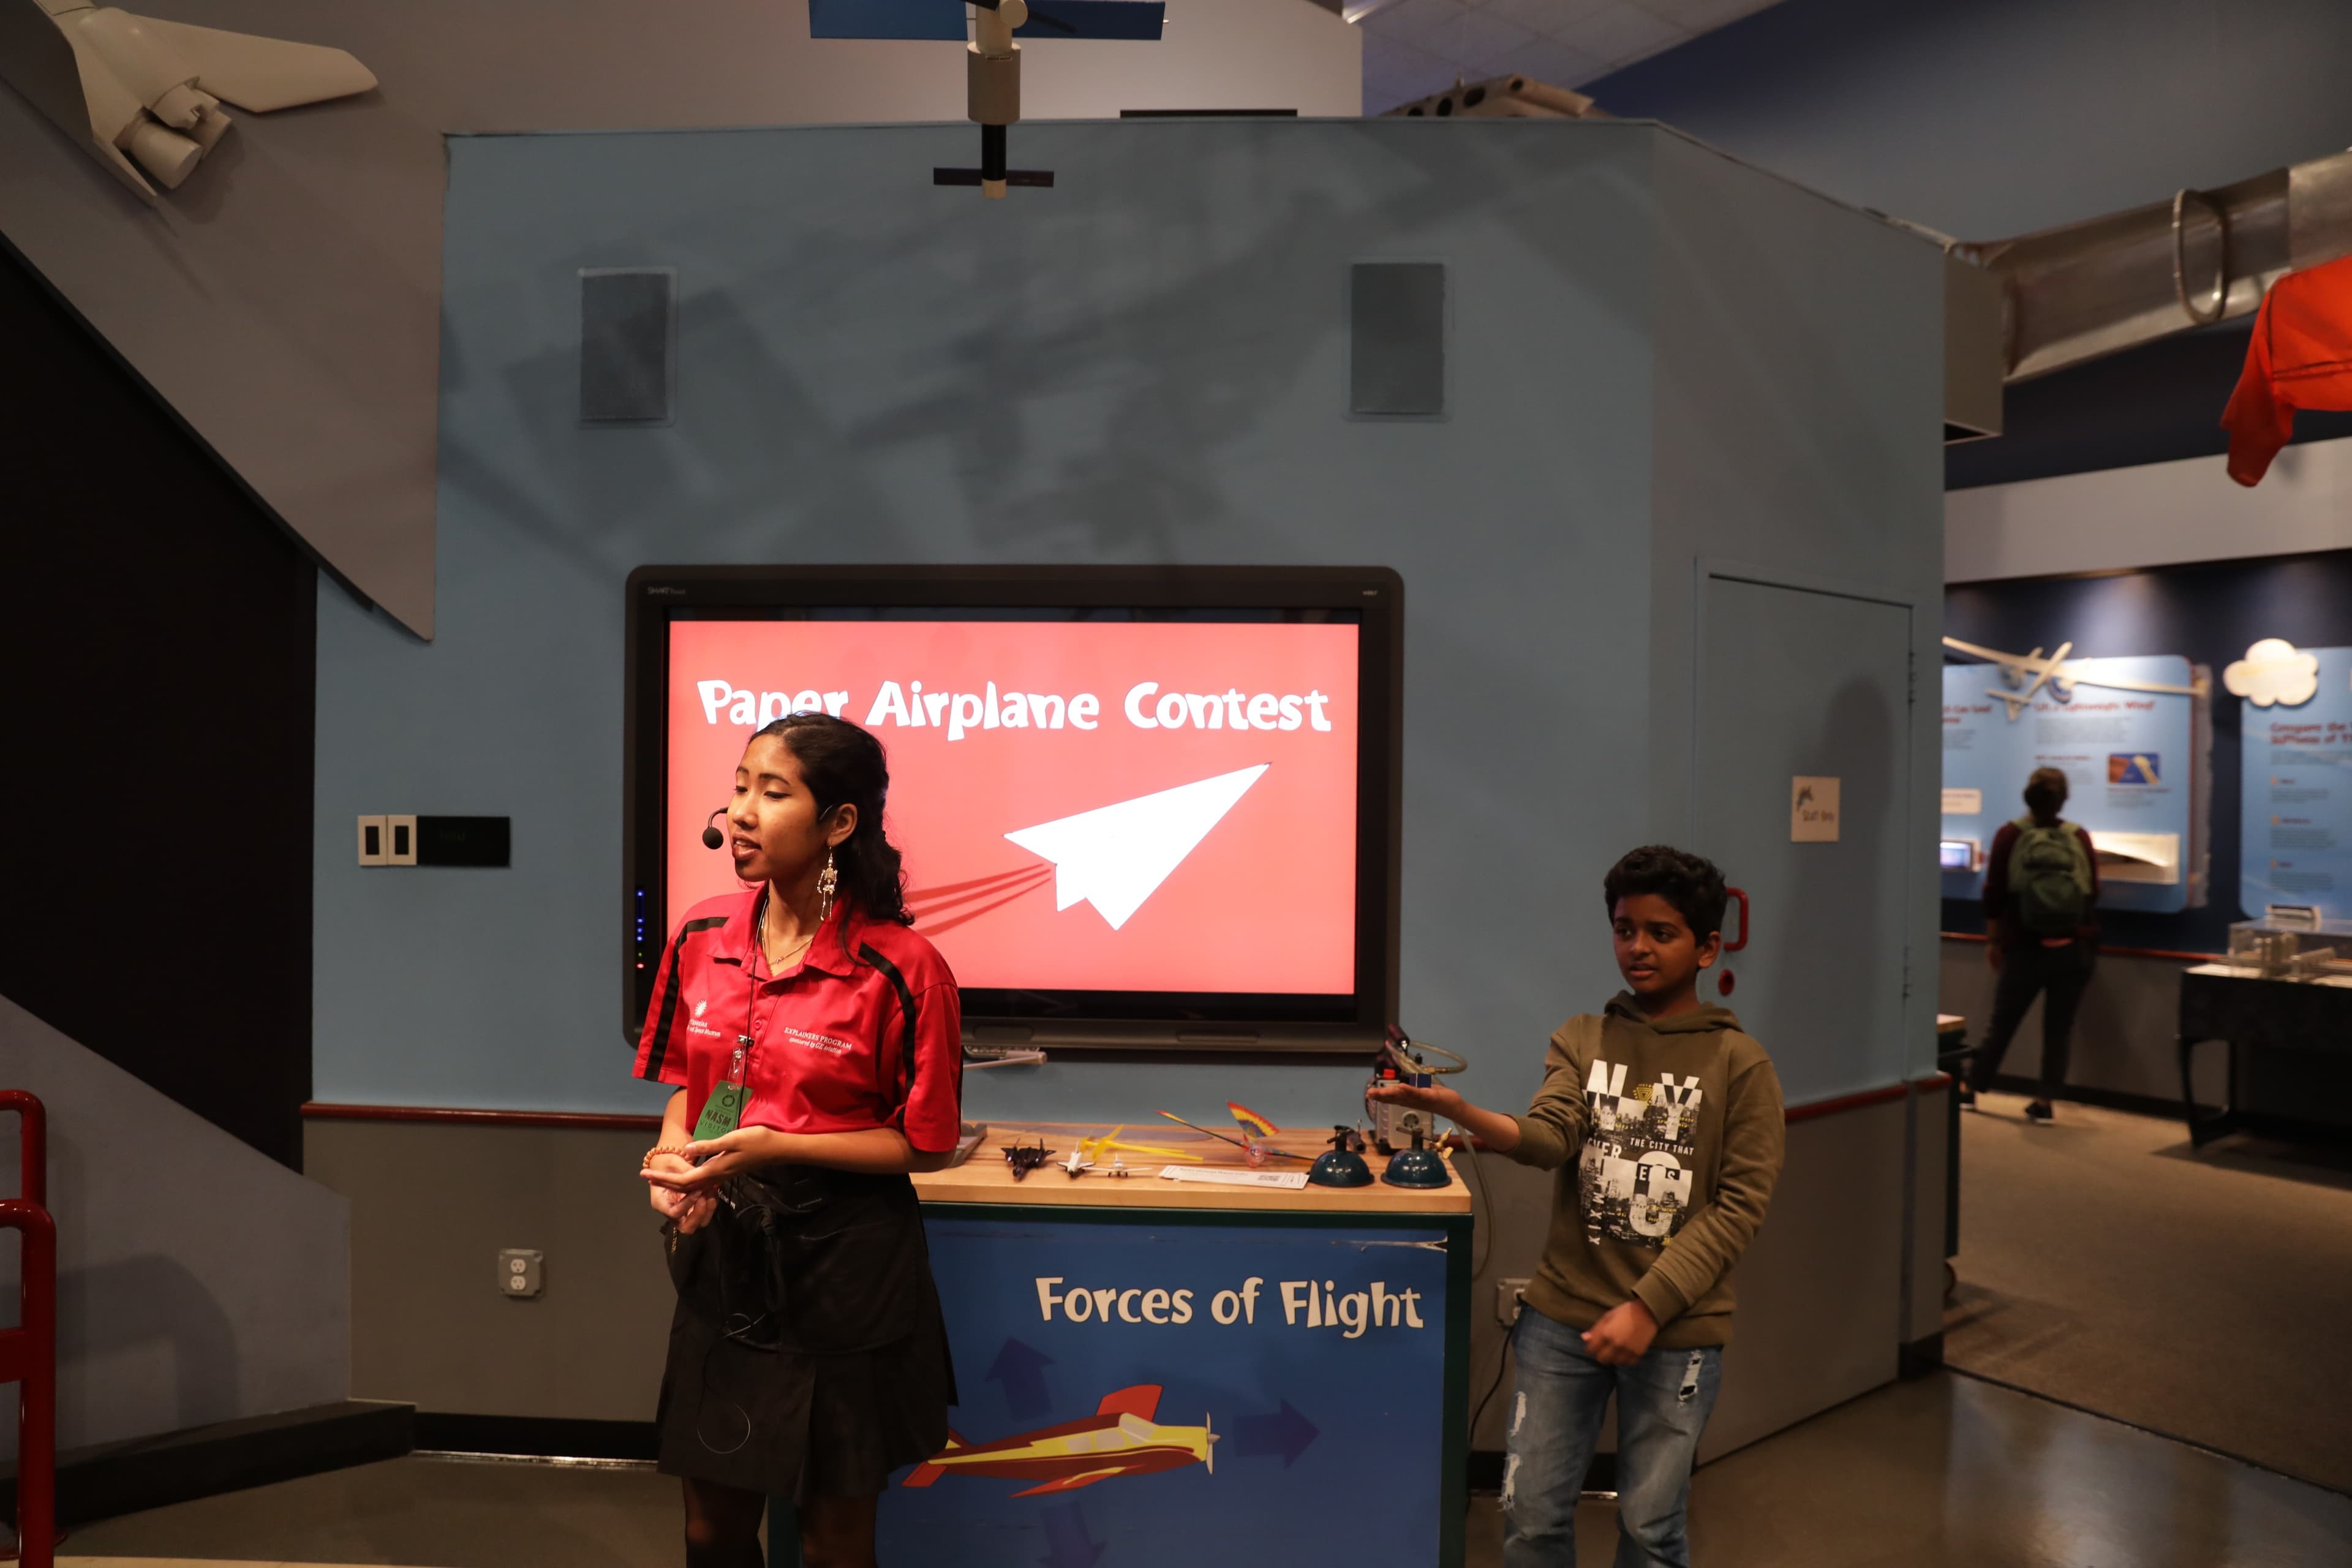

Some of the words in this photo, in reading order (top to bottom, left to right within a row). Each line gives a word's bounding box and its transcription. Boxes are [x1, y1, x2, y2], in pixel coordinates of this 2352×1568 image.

[697, 679, 850, 733] Paper
[865, 680, 1100, 742] Airplane
[1124, 681, 1332, 733] Contest
[784, 1027, 820, 1041] EXPLAINERS
[820, 1036, 852, 1050] PROGRAM
[789, 1037, 810, 1047] sponsored
[704, 1109, 732, 1127] NASM
[1630, 1137, 1645, 1148] THE
[1649, 1140, 1670, 1152] CITY
[1673, 1145, 1695, 1156] THAT
[1035, 1276, 1194, 1324] Forces
[1211, 1276, 1264, 1325] of
[1280, 1279, 1424, 1338] Flight
